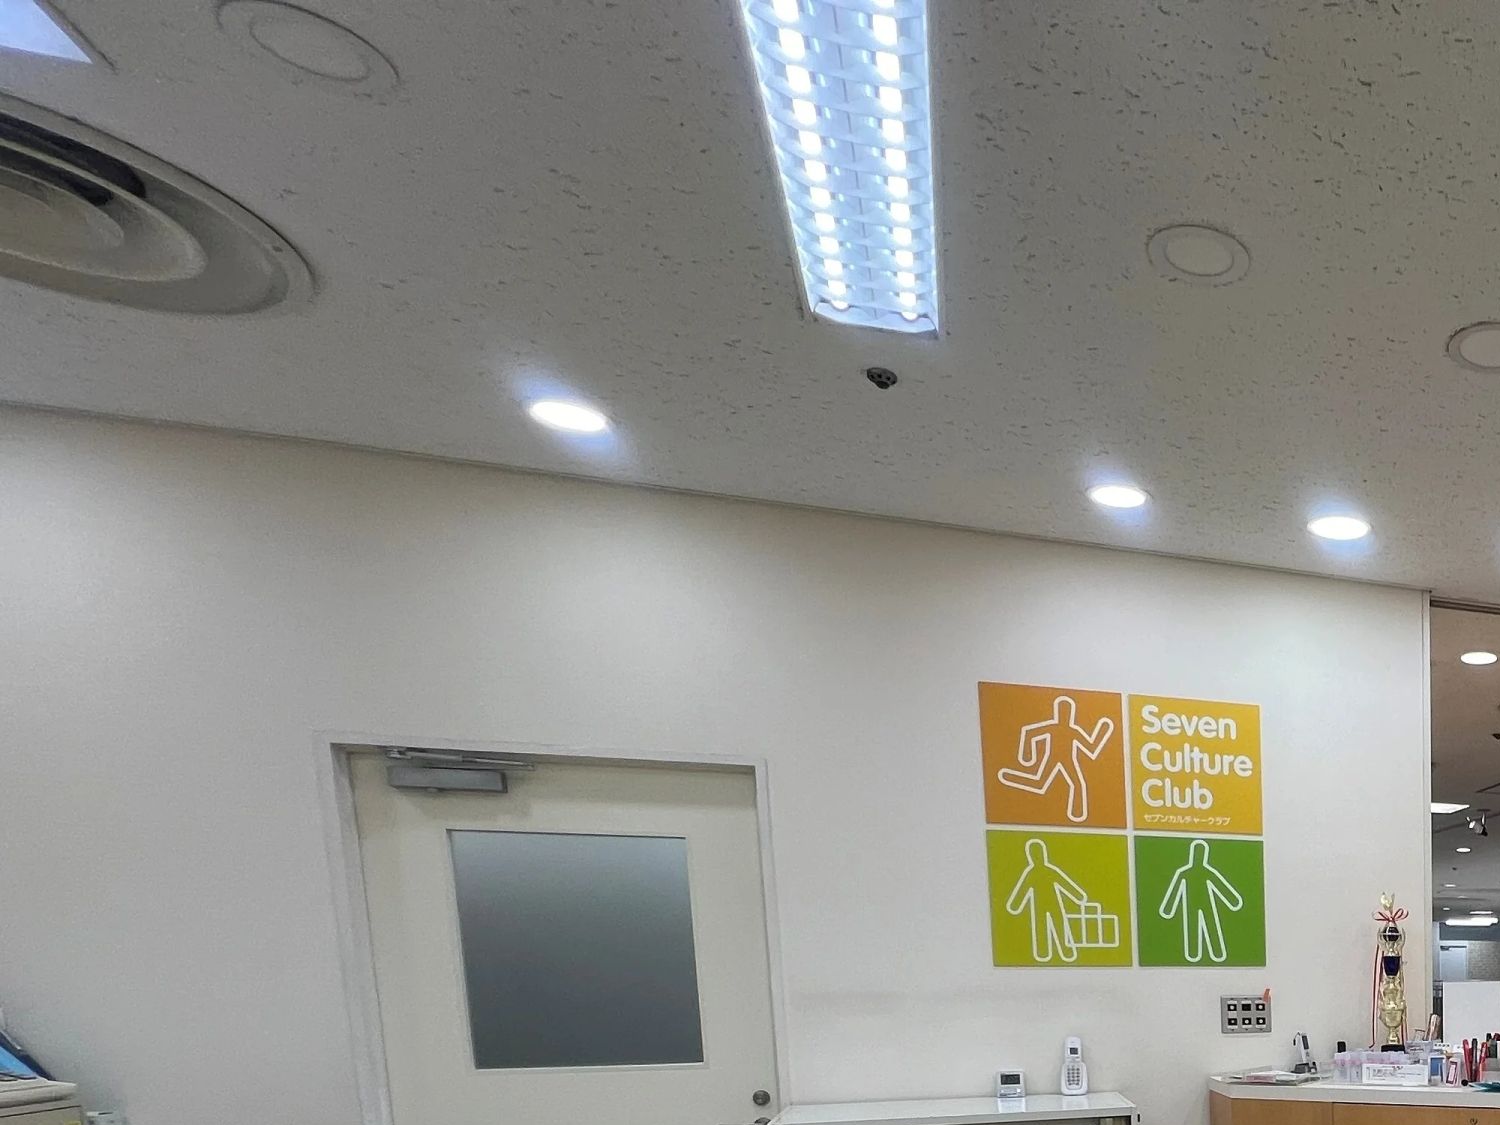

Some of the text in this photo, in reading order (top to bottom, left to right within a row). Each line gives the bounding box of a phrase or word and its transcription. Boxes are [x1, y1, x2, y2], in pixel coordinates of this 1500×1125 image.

[1141, 704, 1237, 740] Seven
[1140, 742, 1253, 777] Culture
[1141, 777, 1213, 810] Club
[1143, 813, 1232, 826] セブンカルチャークラブ
